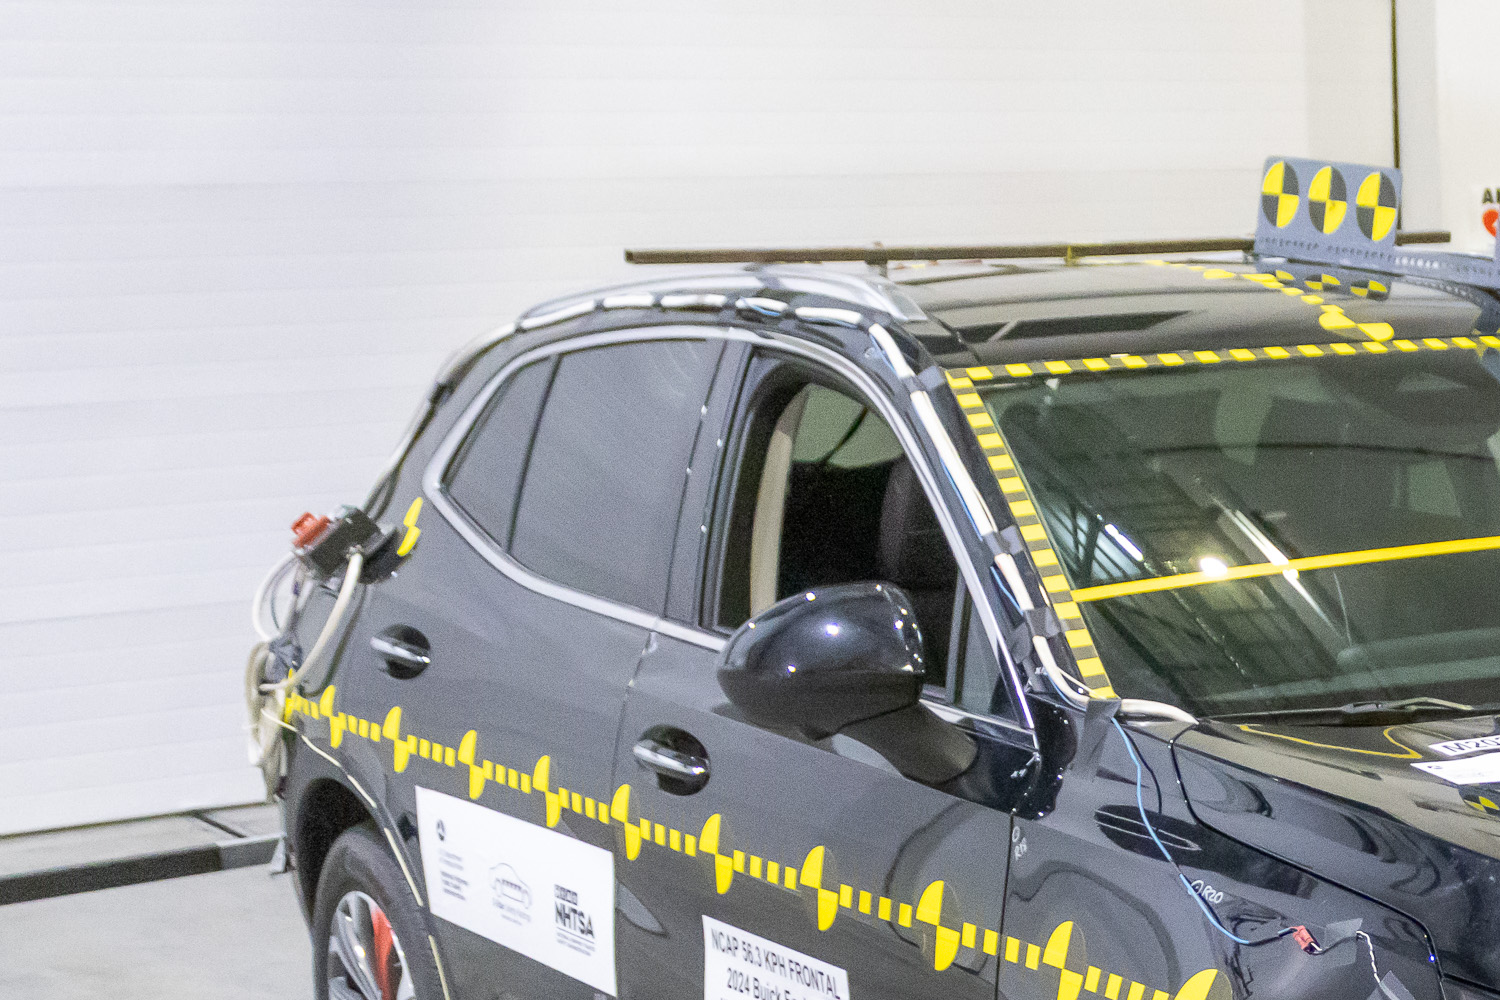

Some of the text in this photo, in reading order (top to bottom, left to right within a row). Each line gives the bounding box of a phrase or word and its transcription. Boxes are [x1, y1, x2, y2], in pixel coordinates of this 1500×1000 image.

[1201, 885, 1224, 904] R20
[555, 901, 595, 939] NHTSA
[710, 928, 841, 1000] NCAP 56.3 KPH FRONTAL
[726, 967, 750, 997] 2024
